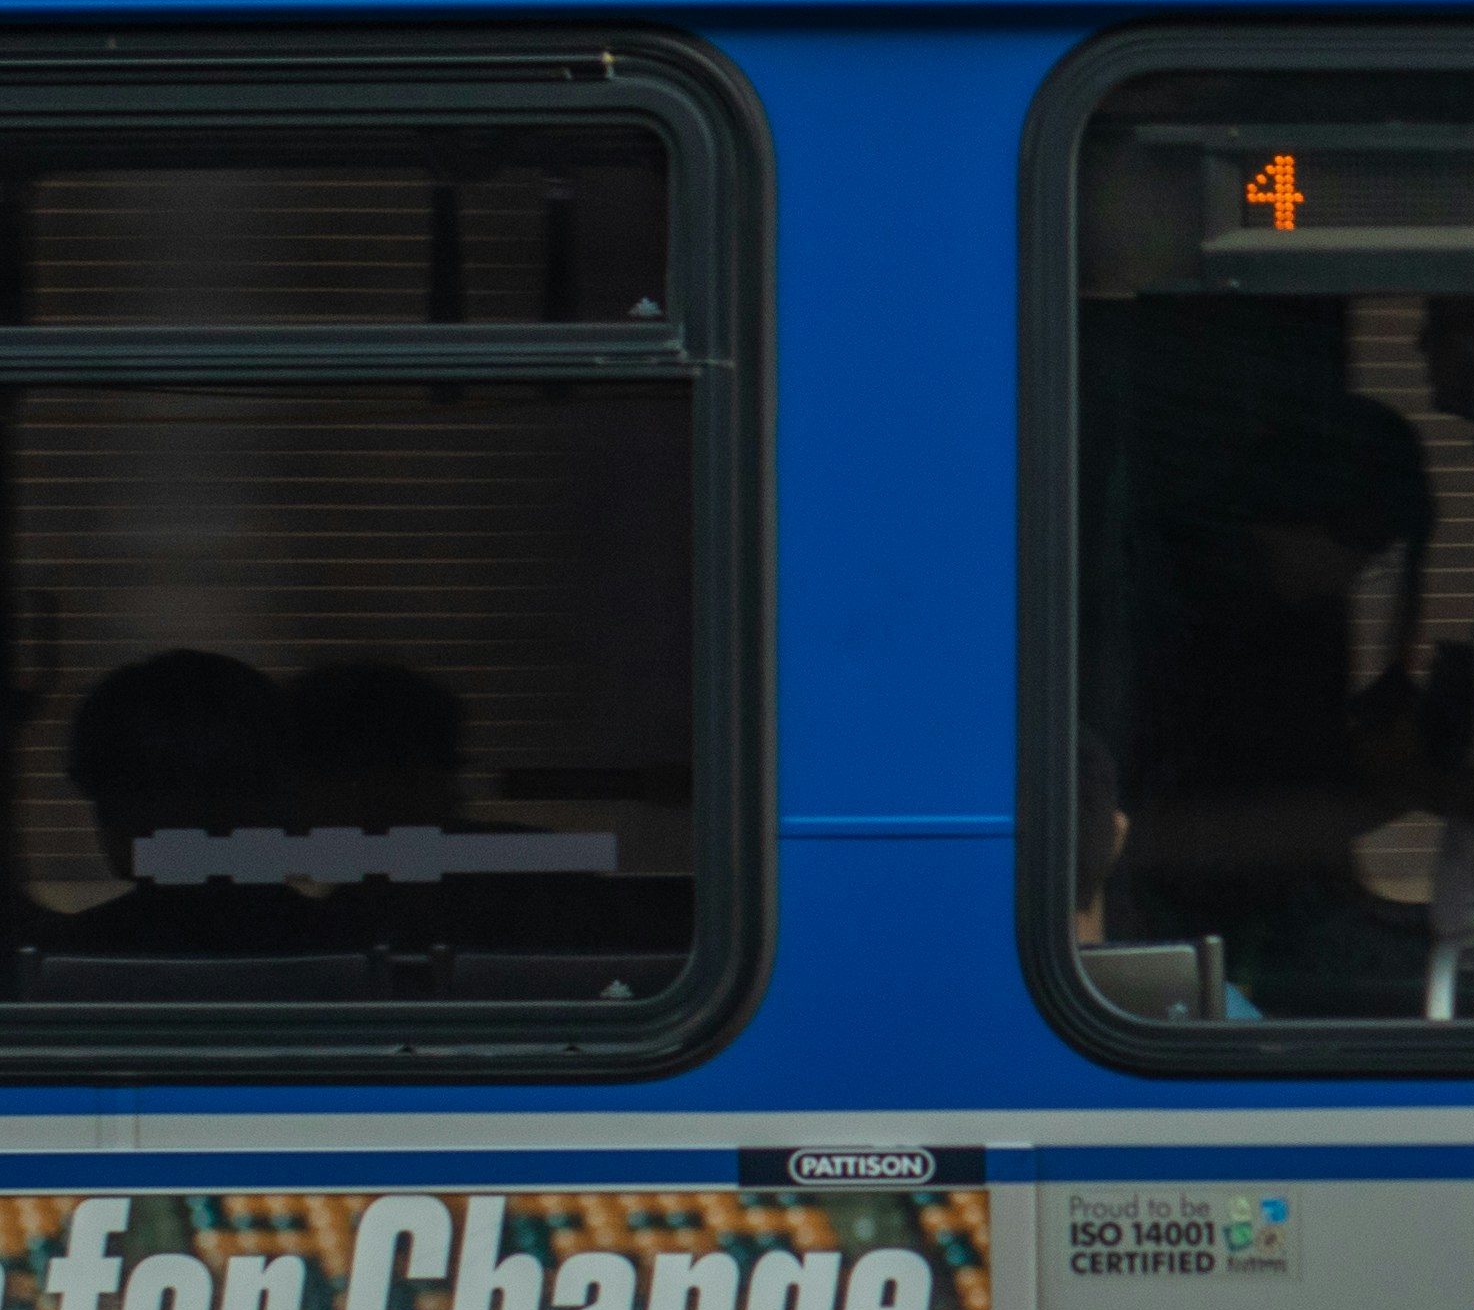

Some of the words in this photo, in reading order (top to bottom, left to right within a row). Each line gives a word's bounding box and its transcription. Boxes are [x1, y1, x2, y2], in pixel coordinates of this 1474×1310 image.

[1246, 153, 1304, 231] 4
[801, 1154, 926, 1178] PATTISON
[1069, 1194, 1140, 1219] Proud
[1147, 1196, 1173, 1219] to
[1179, 1193, 1211, 1219] be
[1070, 1221, 1124, 1247] ISO
[1131, 1220, 1216, 1247] 14001
[1070, 1250, 1217, 1276] CERTIFIED
